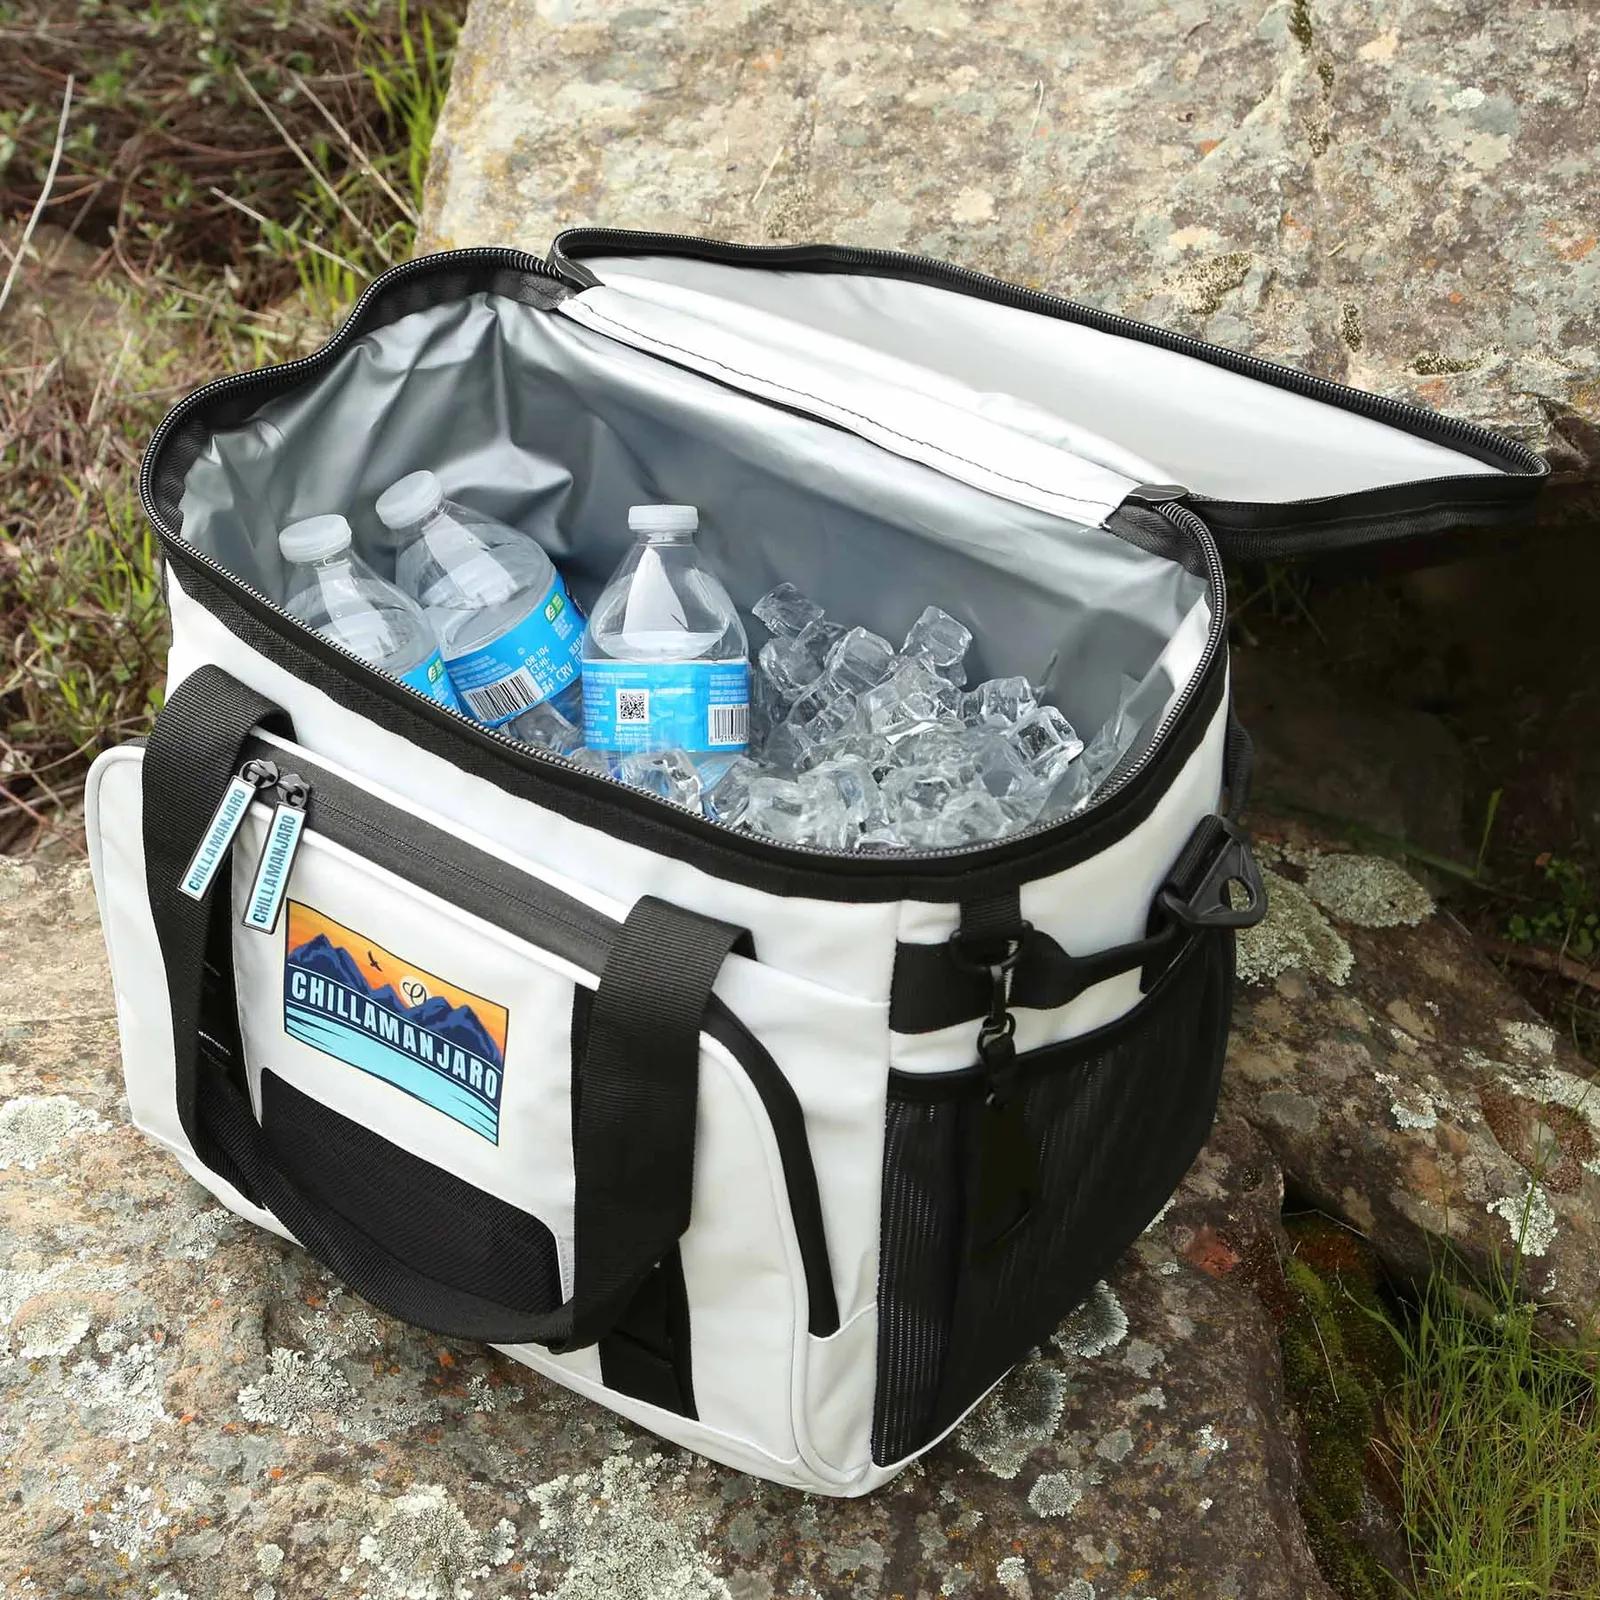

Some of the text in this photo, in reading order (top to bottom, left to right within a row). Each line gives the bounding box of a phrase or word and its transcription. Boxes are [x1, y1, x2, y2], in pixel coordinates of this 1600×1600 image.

[555, 661, 574, 683] CRV
[188, 788, 247, 892] CHILLAMANJARO
[252, 814, 297, 924] CHILLAMANJARO
[291, 971, 498, 1100] CHILLAMANJARO
